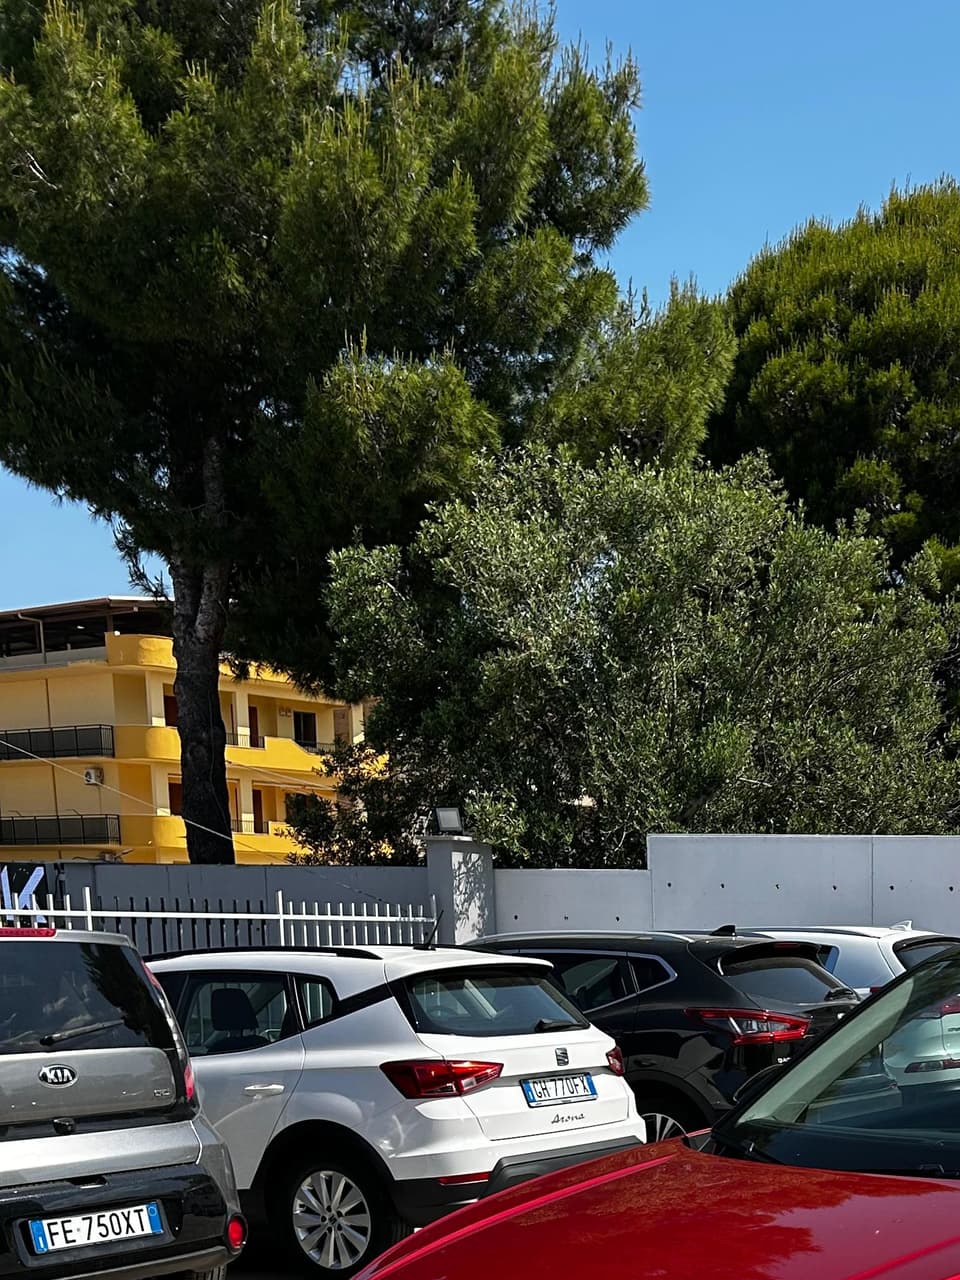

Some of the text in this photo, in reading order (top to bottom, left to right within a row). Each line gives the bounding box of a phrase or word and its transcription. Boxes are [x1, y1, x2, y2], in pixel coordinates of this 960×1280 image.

[43, 1068, 73, 1083] KIA
[550, 1075, 589, 1097] 770FX
[551, 1113, 585, 1124] Arona
[47, 1208, 146, 1246] FE 750XT
